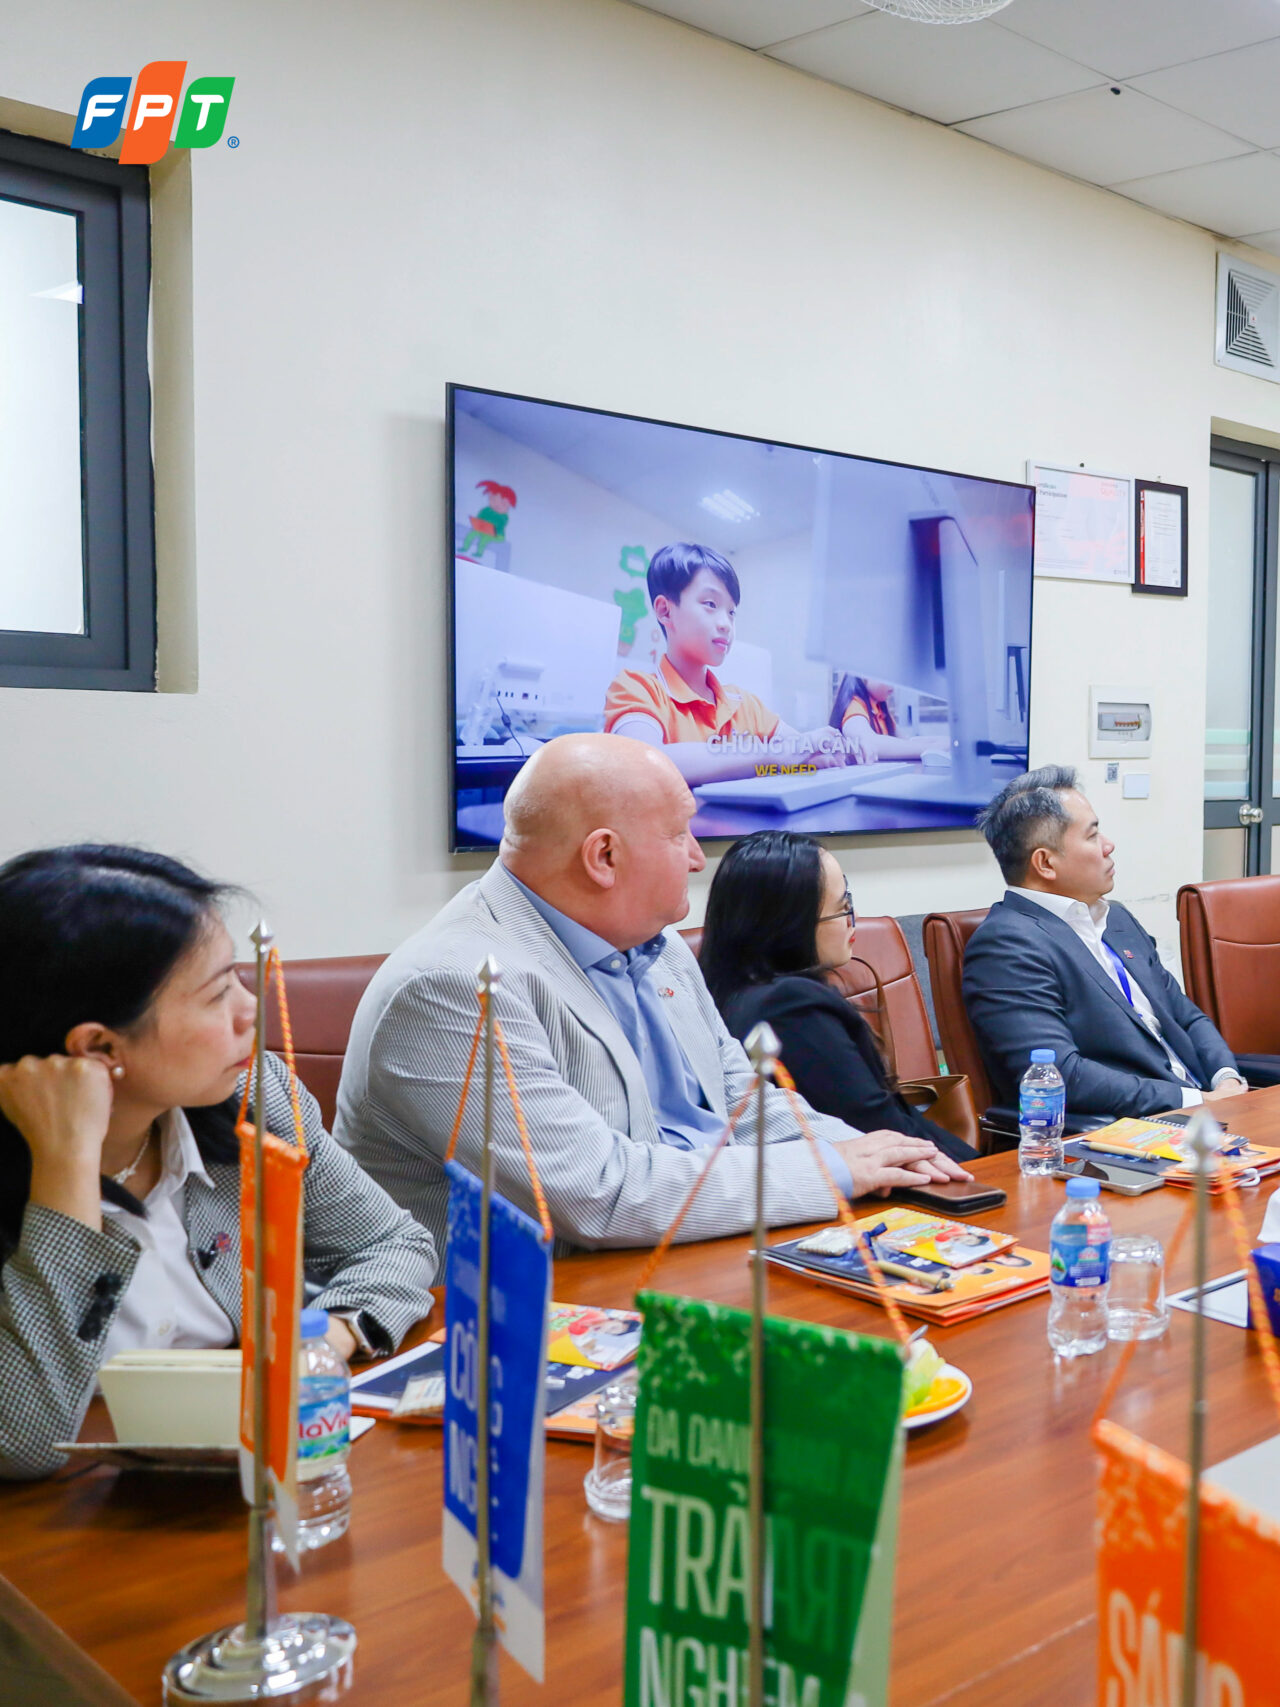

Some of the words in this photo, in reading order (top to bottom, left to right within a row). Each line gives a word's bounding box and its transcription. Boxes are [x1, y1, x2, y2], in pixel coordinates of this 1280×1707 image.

[788, 735, 813, 755] TA
[755, 764, 778, 777] WE
[781, 764, 817, 777] NEED
